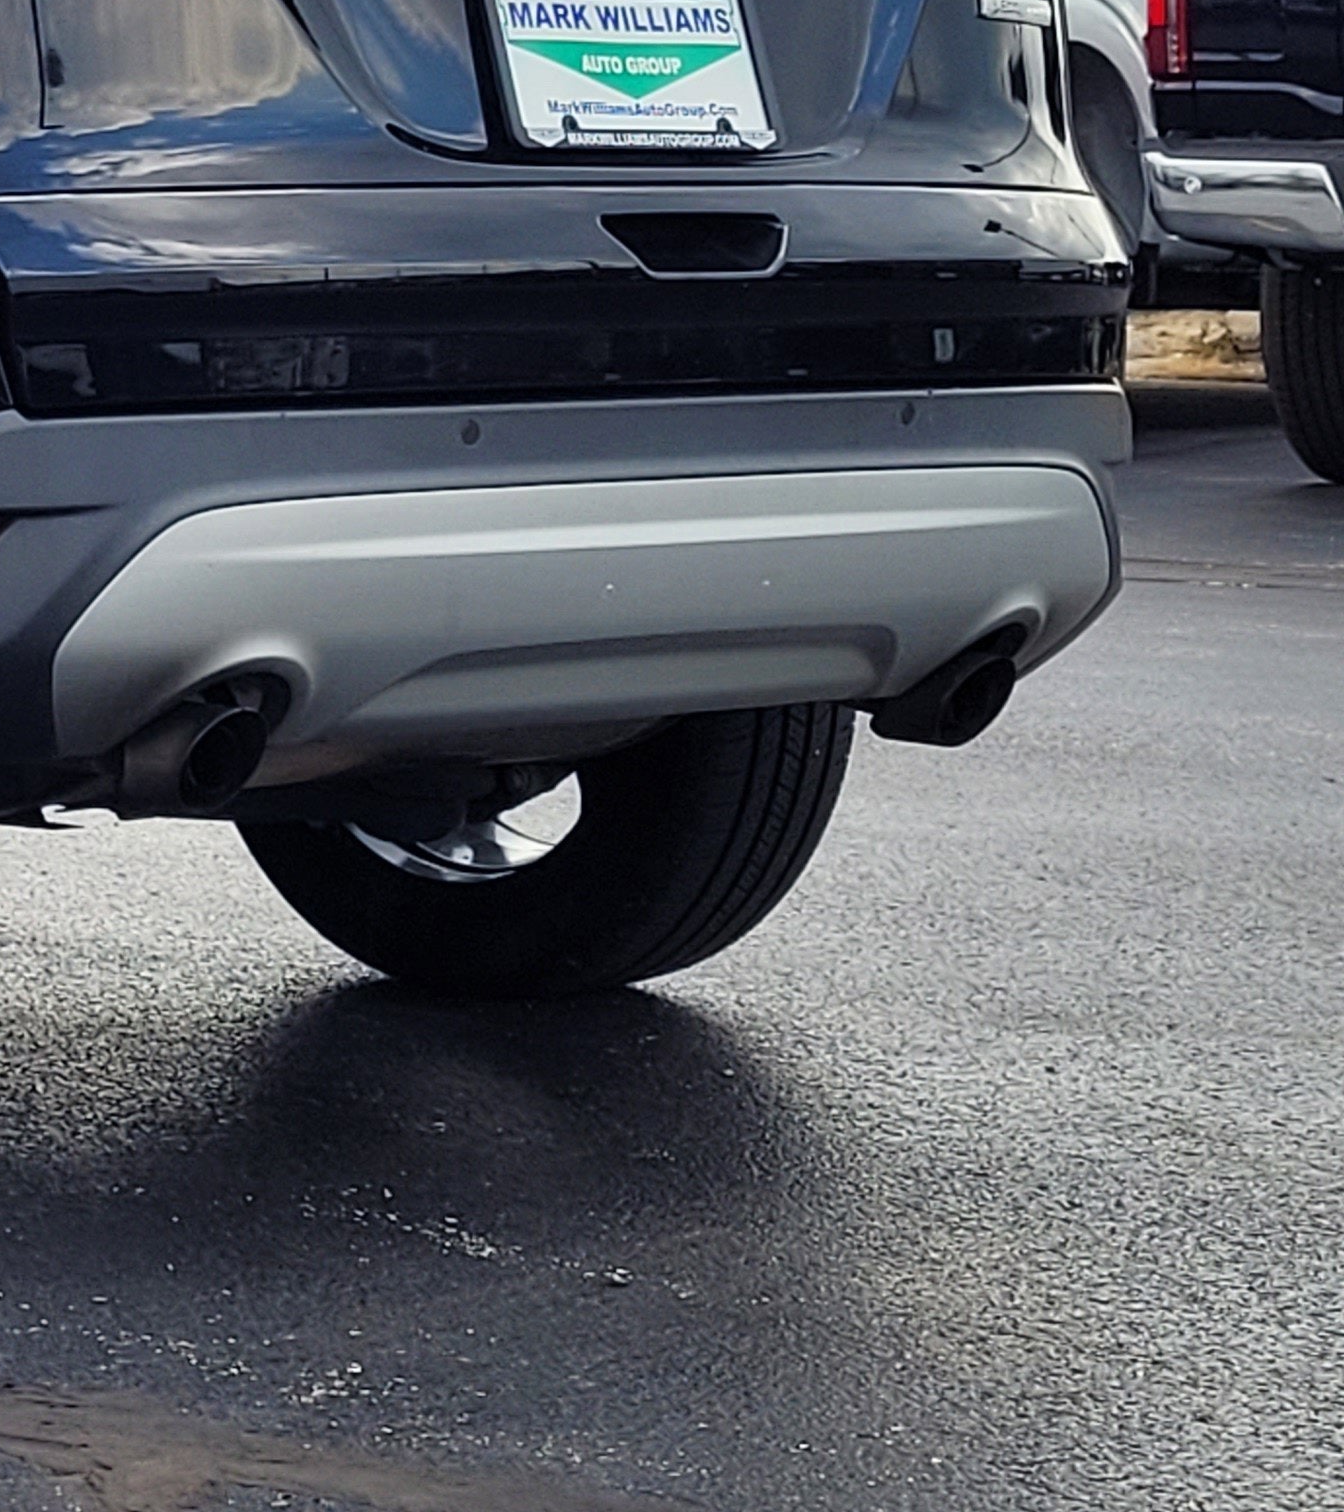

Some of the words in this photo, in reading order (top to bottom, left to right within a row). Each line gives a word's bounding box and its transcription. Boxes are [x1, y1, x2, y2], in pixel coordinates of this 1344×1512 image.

[507, 2, 592, 31] MARK
[594, 5, 731, 34] WILLIAMS
[581, 53, 624, 75] AUTO
[625, 57, 683, 76] GROUP
